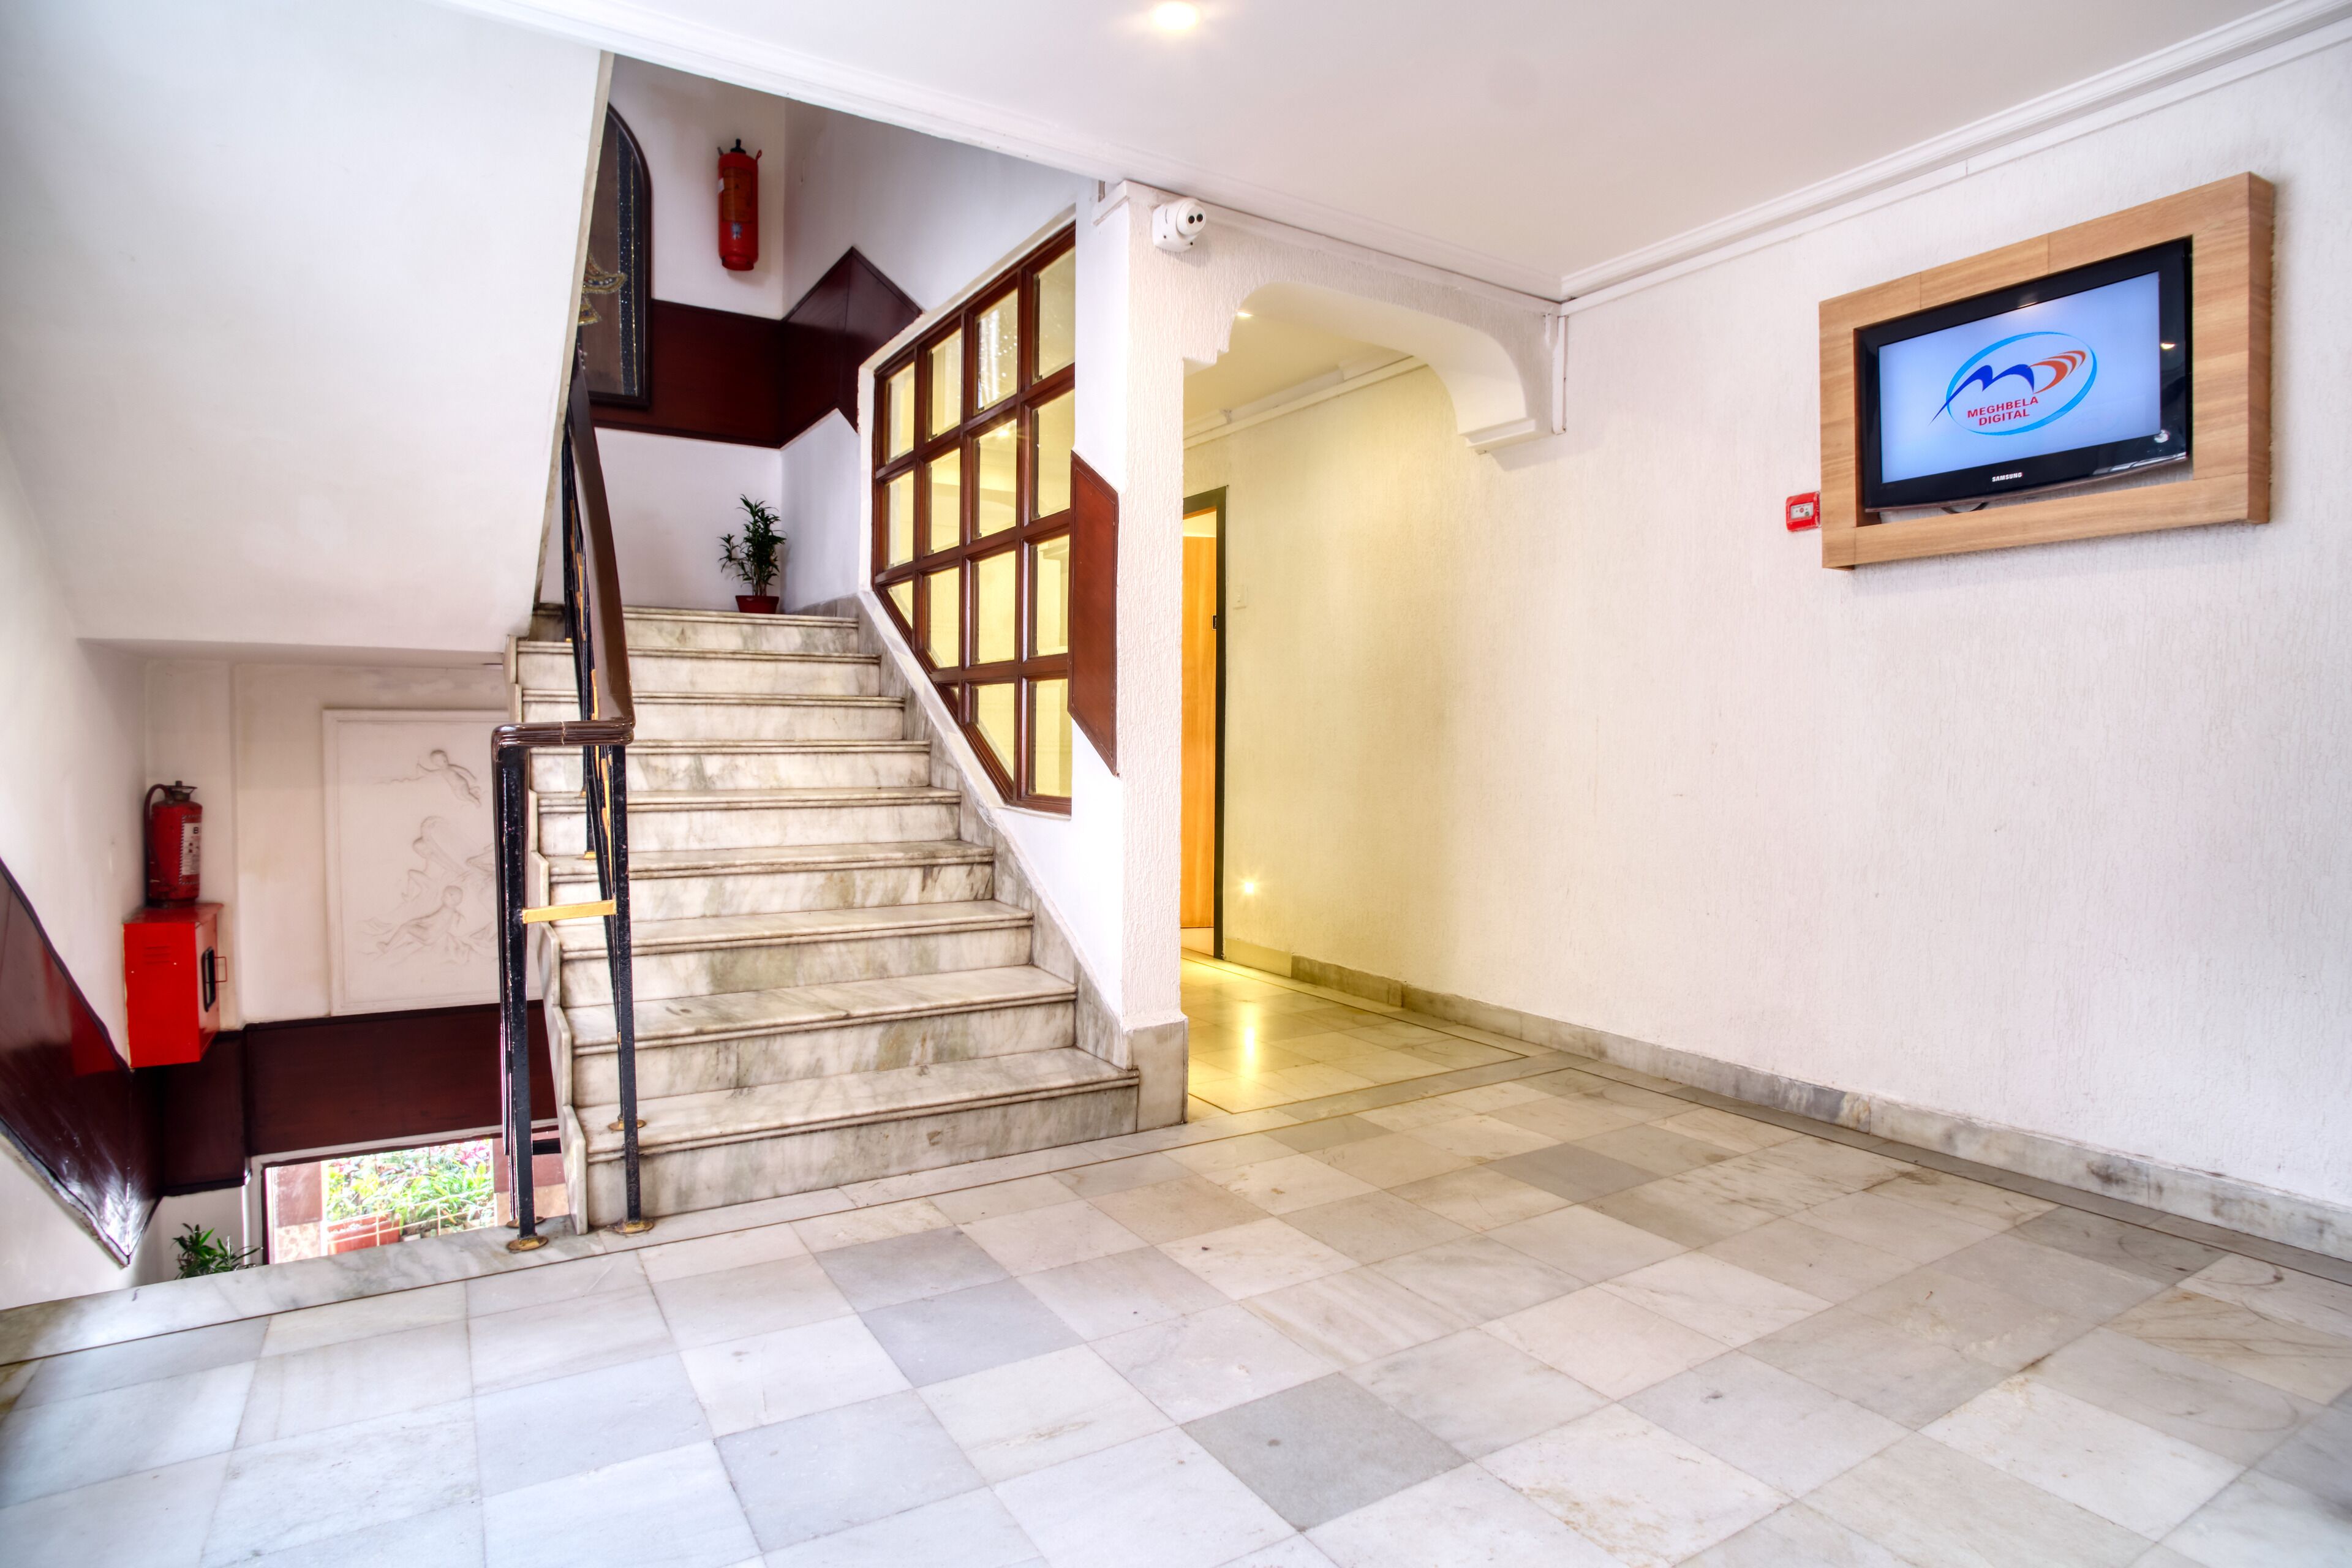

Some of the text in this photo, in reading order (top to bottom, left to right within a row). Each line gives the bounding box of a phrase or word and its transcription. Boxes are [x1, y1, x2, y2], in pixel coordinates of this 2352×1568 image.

[1967, 396, 2038, 418] MEGHBELA
[1979, 409, 2030, 426] DIGITAL
[1992, 472, 2022, 482] SAMSUNG
